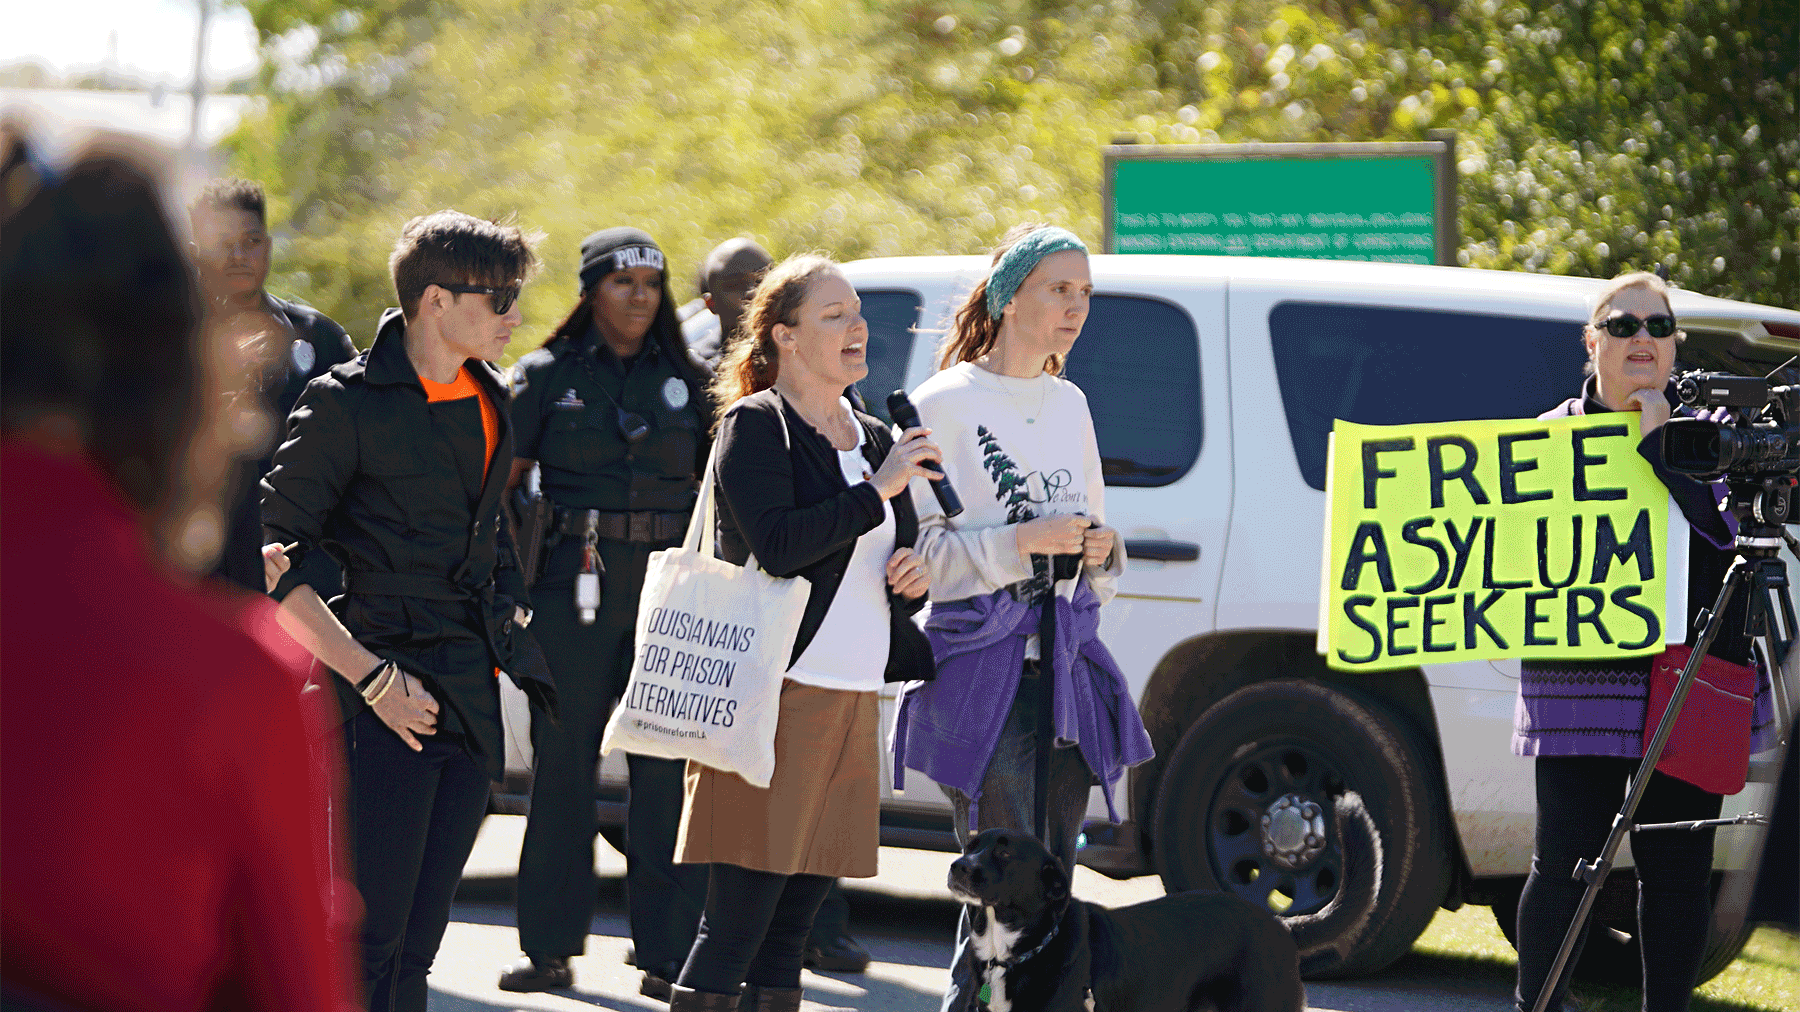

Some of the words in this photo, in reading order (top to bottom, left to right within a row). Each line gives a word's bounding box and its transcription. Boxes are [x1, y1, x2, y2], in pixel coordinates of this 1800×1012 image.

[1362, 424, 1629, 509] FREE
[1341, 508, 1655, 595] ASYLUM
[647, 607, 755, 653] OUISIANANS
[1337, 585, 1661, 664] SEEKERS
[670, 650, 737, 688] PRISON
